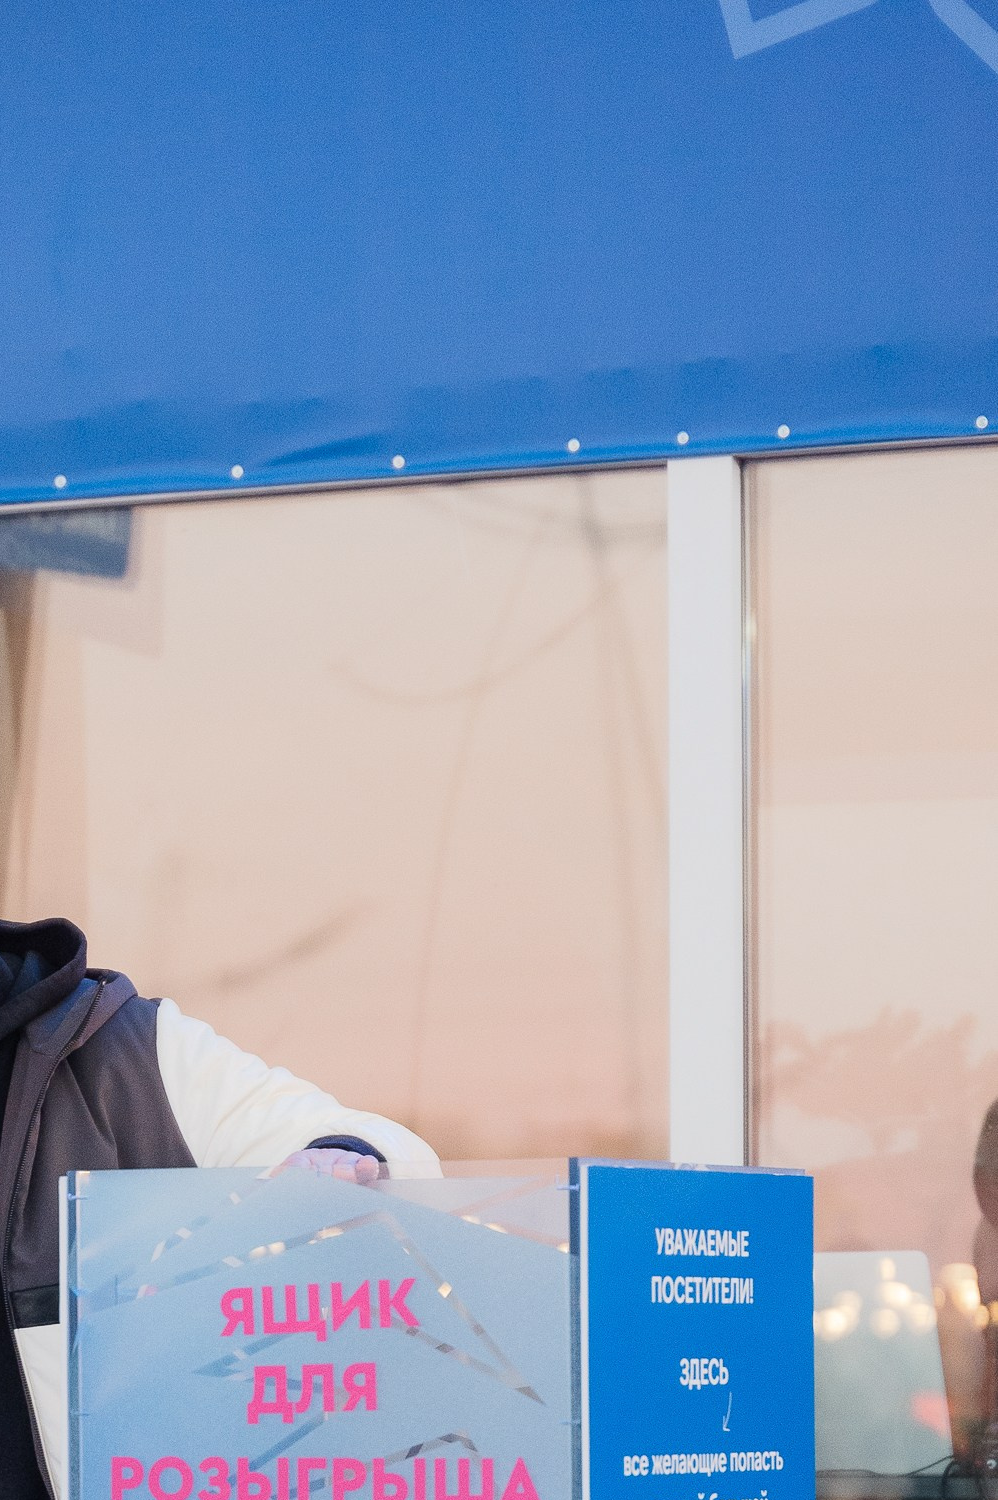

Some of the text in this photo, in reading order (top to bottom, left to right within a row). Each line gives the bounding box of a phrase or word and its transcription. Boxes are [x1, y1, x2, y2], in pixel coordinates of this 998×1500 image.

[655, 1227, 750, 1257] УВАЖАЕМЫЕ
[651, 1275, 754, 1304] ПОСЕТИТЕЛИ!
[220, 1277, 421, 1342] ЯЩИК
[679, 1358, 729, 1390] ЗДЕСЬ
[246, 1362, 377, 1424] ДЛЯ
[623, 1450, 784, 1477] все желающие попасть
